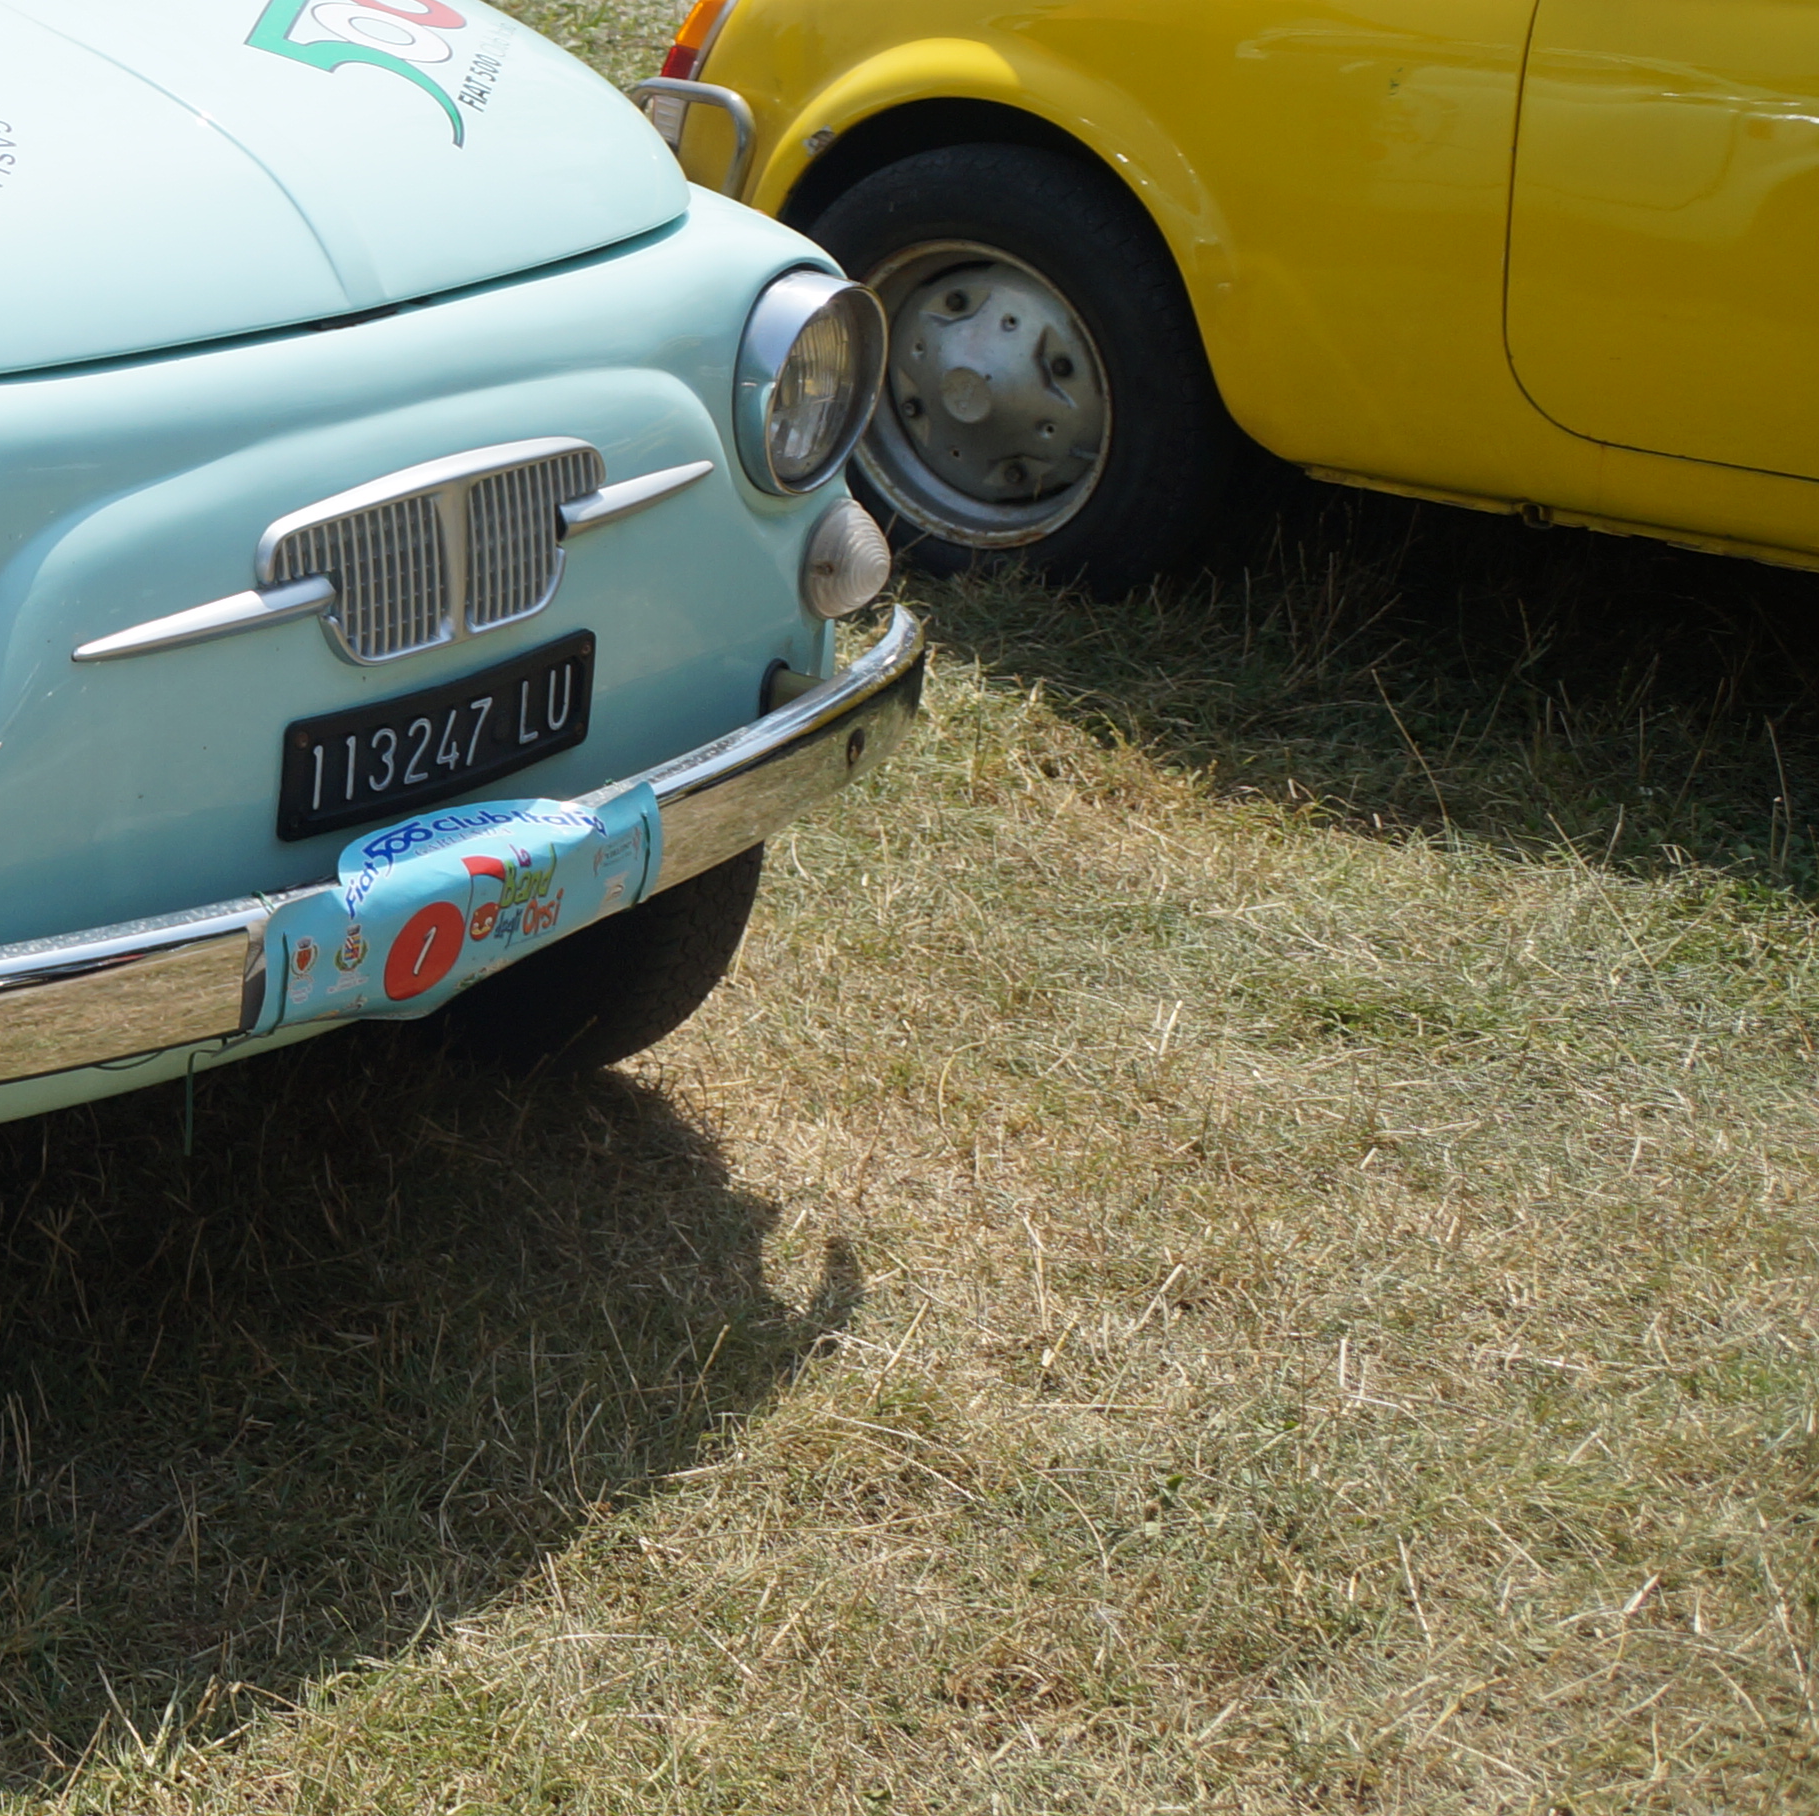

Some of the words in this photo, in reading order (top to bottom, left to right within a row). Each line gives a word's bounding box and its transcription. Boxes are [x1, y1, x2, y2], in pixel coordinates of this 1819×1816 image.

[469, 53, 503, 83] 500
[458, 75, 494, 113] FIAT
[313, 696, 493, 811] 113247
[518, 663, 572, 745] LU
[344, 860, 380, 921] Fiat
[362, 822, 434, 878] 500
[431, 810, 510, 833] Club
[510, 809, 608, 839] Italia
[499, 841, 558, 909] Band
[521, 886, 565, 936] Orsi
[412, 925, 438, 976] 1
